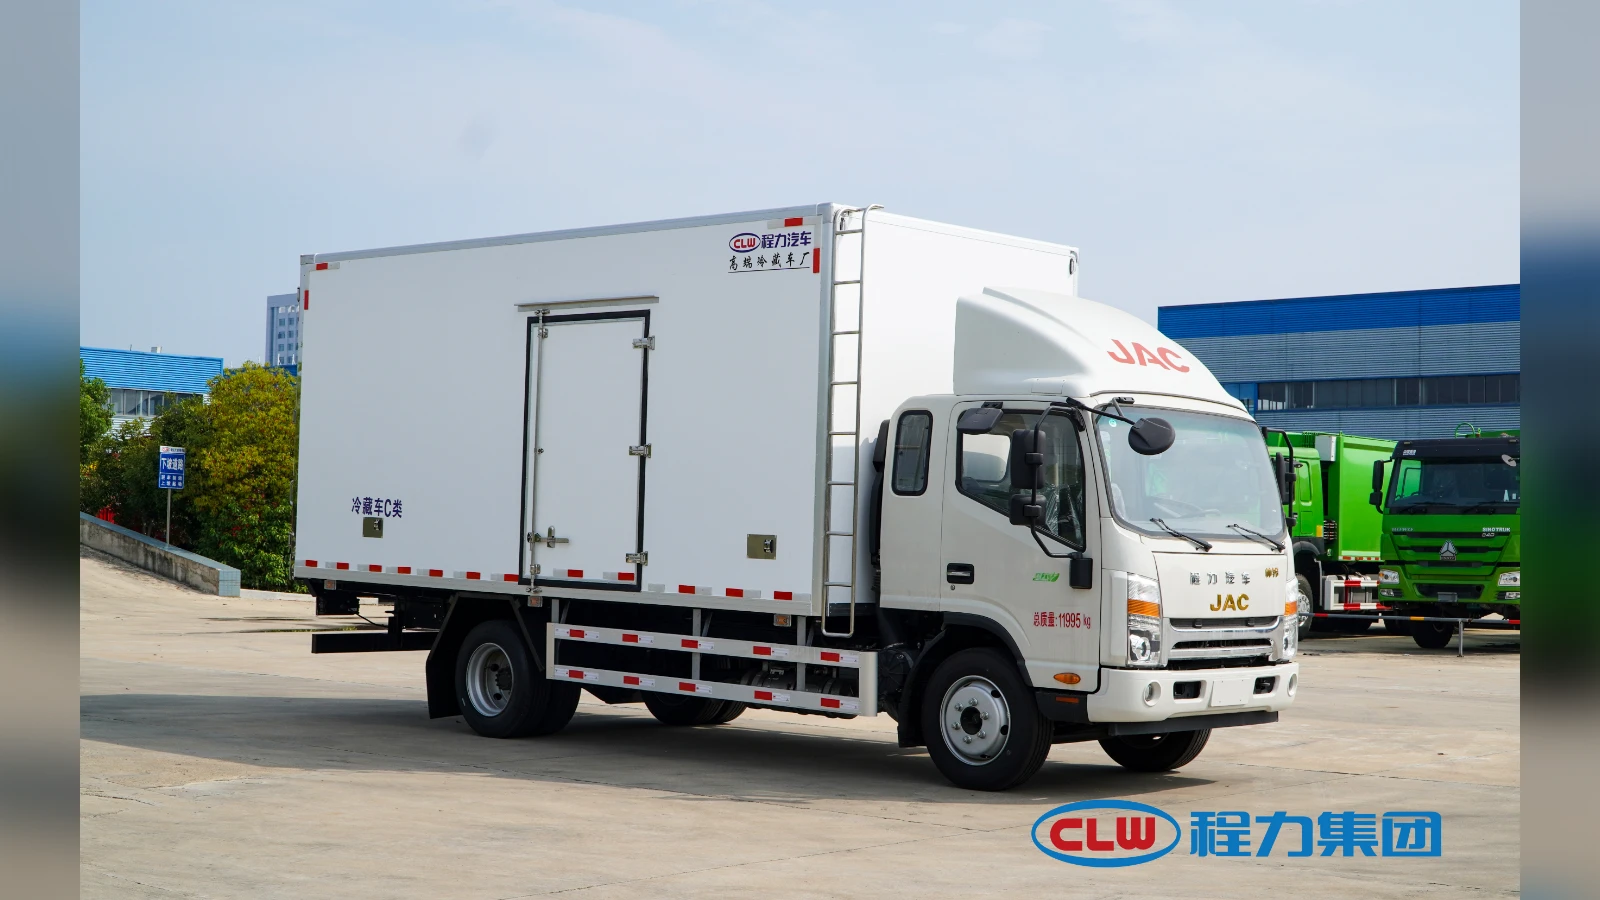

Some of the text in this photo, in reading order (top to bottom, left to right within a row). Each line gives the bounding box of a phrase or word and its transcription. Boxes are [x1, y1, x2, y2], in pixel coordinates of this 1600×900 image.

[733, 230, 812, 249] CLW 程力汽车
[729, 251, 810, 271] 高端冷藏车厂
[1106, 338, 1190, 373] JAC
[351, 496, 403, 518] 冷藏车C类
[1209, 593, 1250, 612] JAC
[1083, 614, 1091, 630] kg
